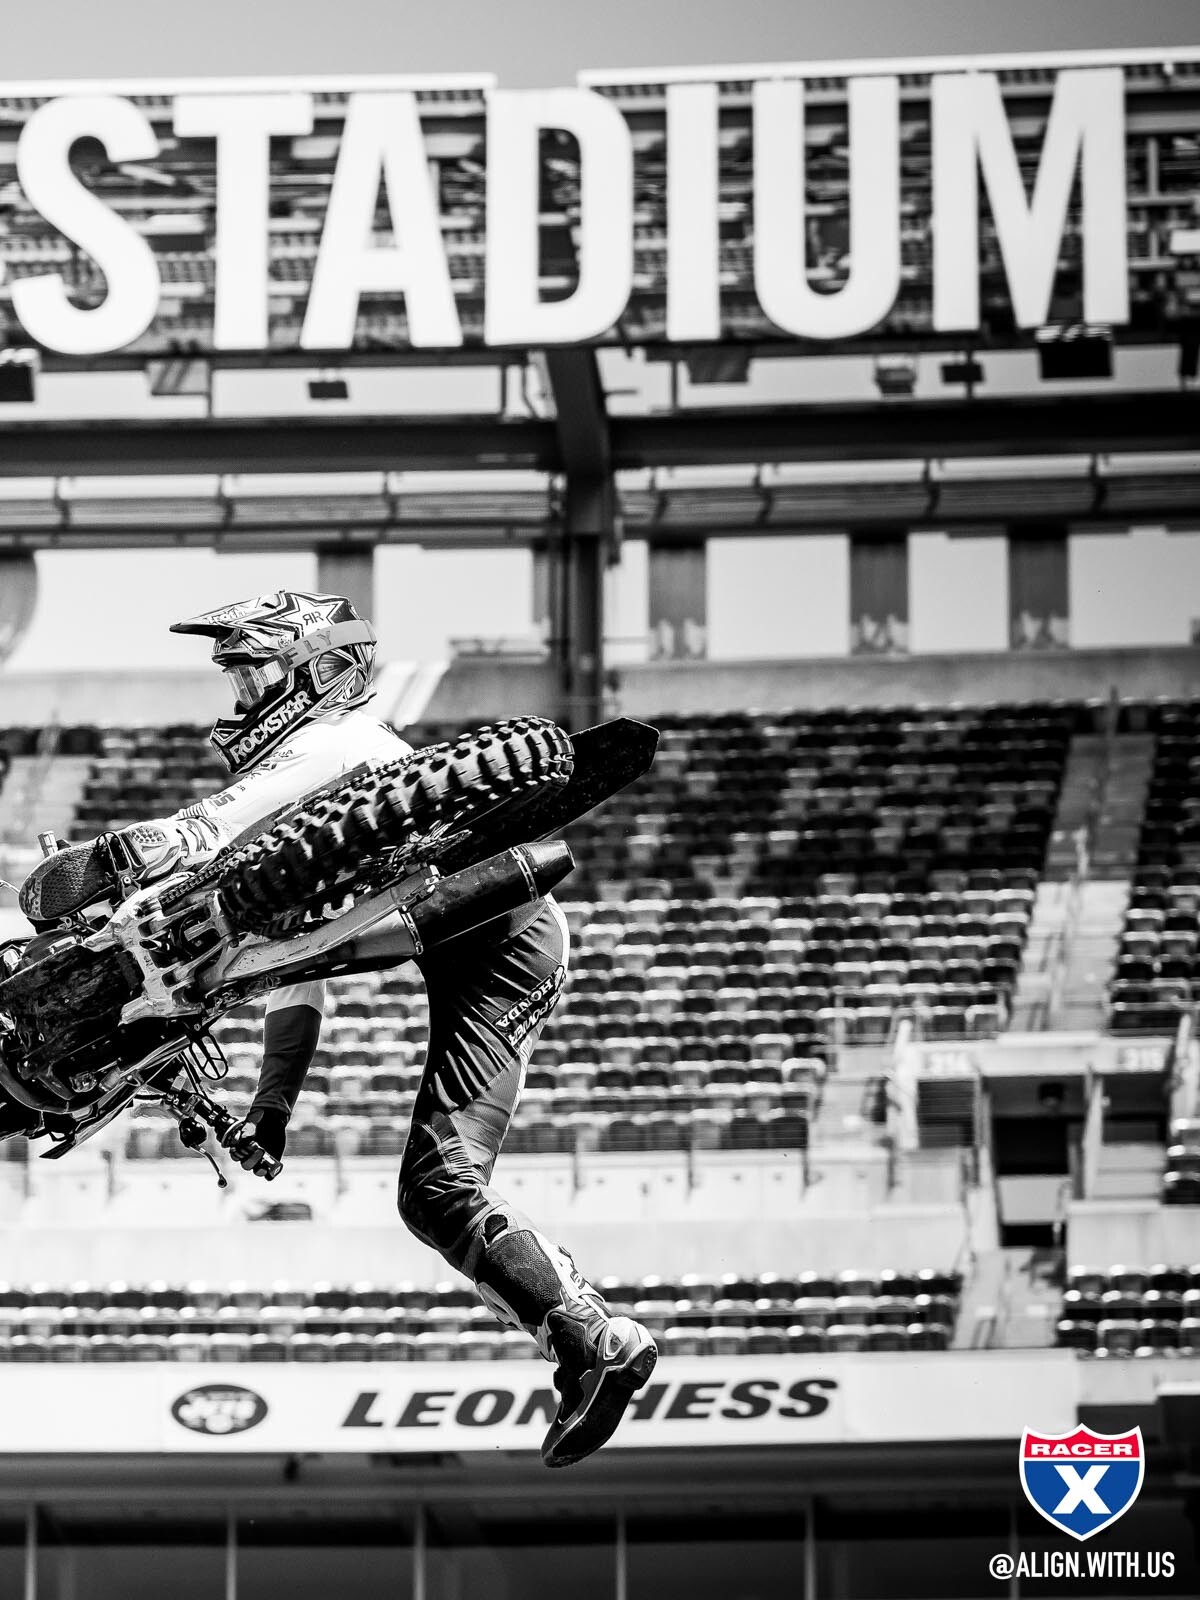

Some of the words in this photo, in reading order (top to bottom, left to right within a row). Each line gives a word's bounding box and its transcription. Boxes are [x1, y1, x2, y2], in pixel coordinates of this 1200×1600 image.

[10, 67, 1131, 356] STADIUM
[281, 630, 333, 667] FLY
[229, 689, 314, 765] ROCKSTAR
[494, 979, 554, 1028] HONDA
